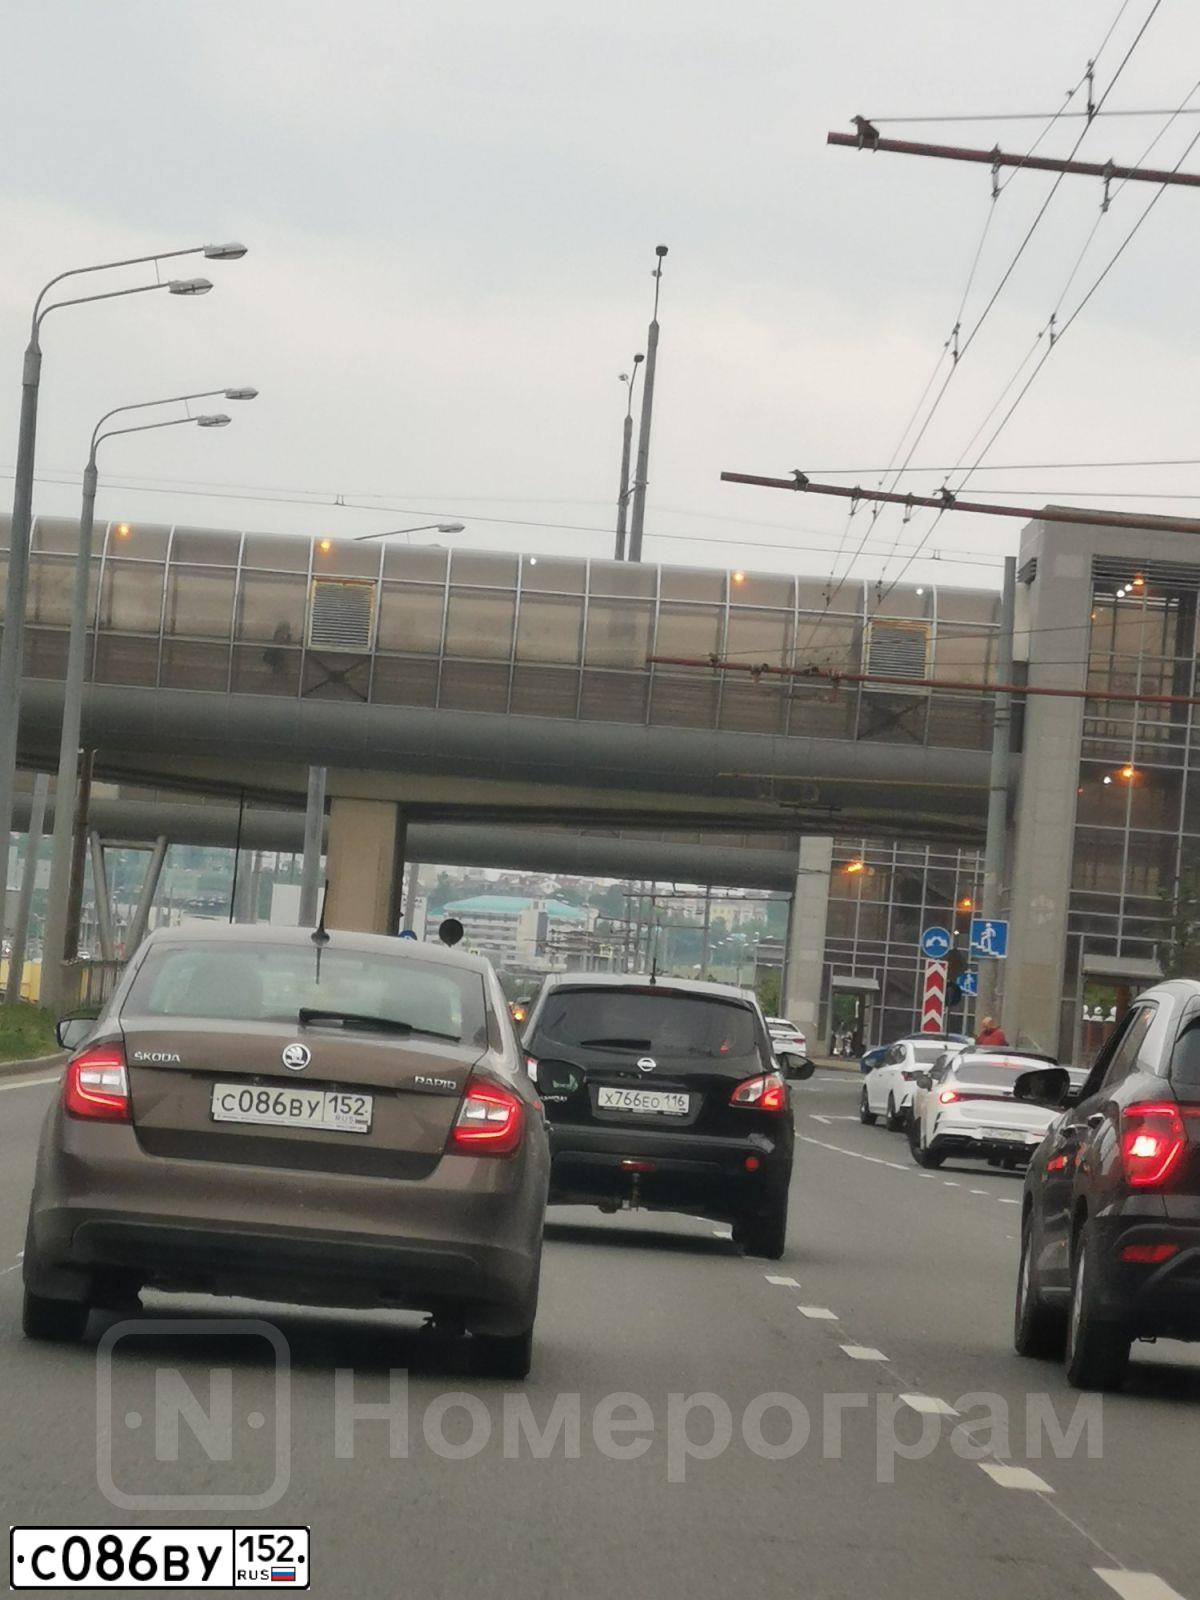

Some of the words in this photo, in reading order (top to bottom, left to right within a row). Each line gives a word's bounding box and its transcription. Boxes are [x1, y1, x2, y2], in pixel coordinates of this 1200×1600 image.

[415, 1076, 457, 1090] RAPID
[328, 1095, 366, 1116] 152
[664, 1094, 685, 1107] 116
